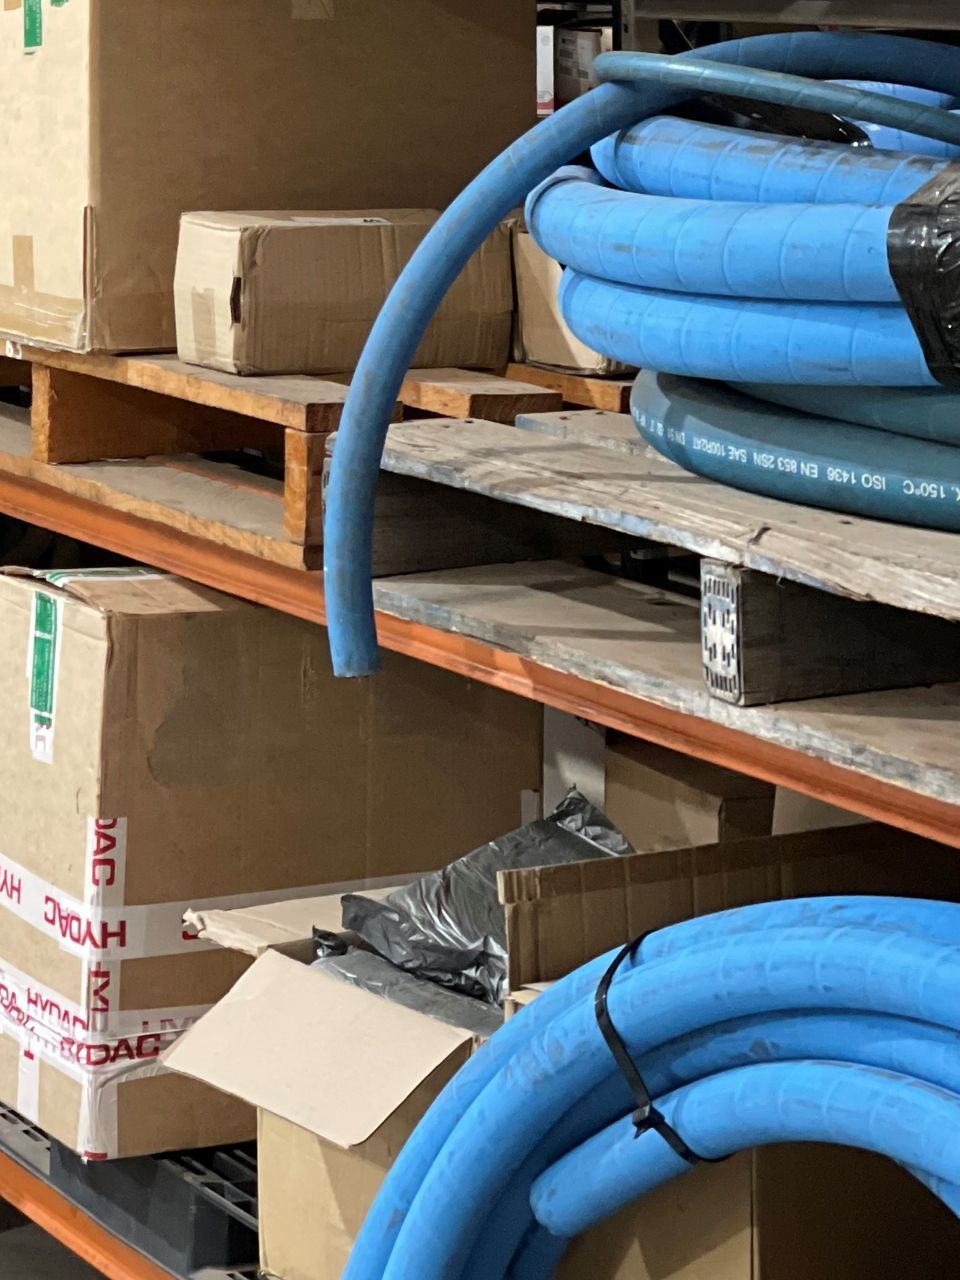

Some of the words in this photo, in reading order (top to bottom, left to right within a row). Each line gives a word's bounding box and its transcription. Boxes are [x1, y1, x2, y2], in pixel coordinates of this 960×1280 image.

[728, 446, 748, 463] SAE
[800, 463, 818, 478] EN
[861, 474, 886, 491] ISO
[44, 895, 127, 949] HYDAC
